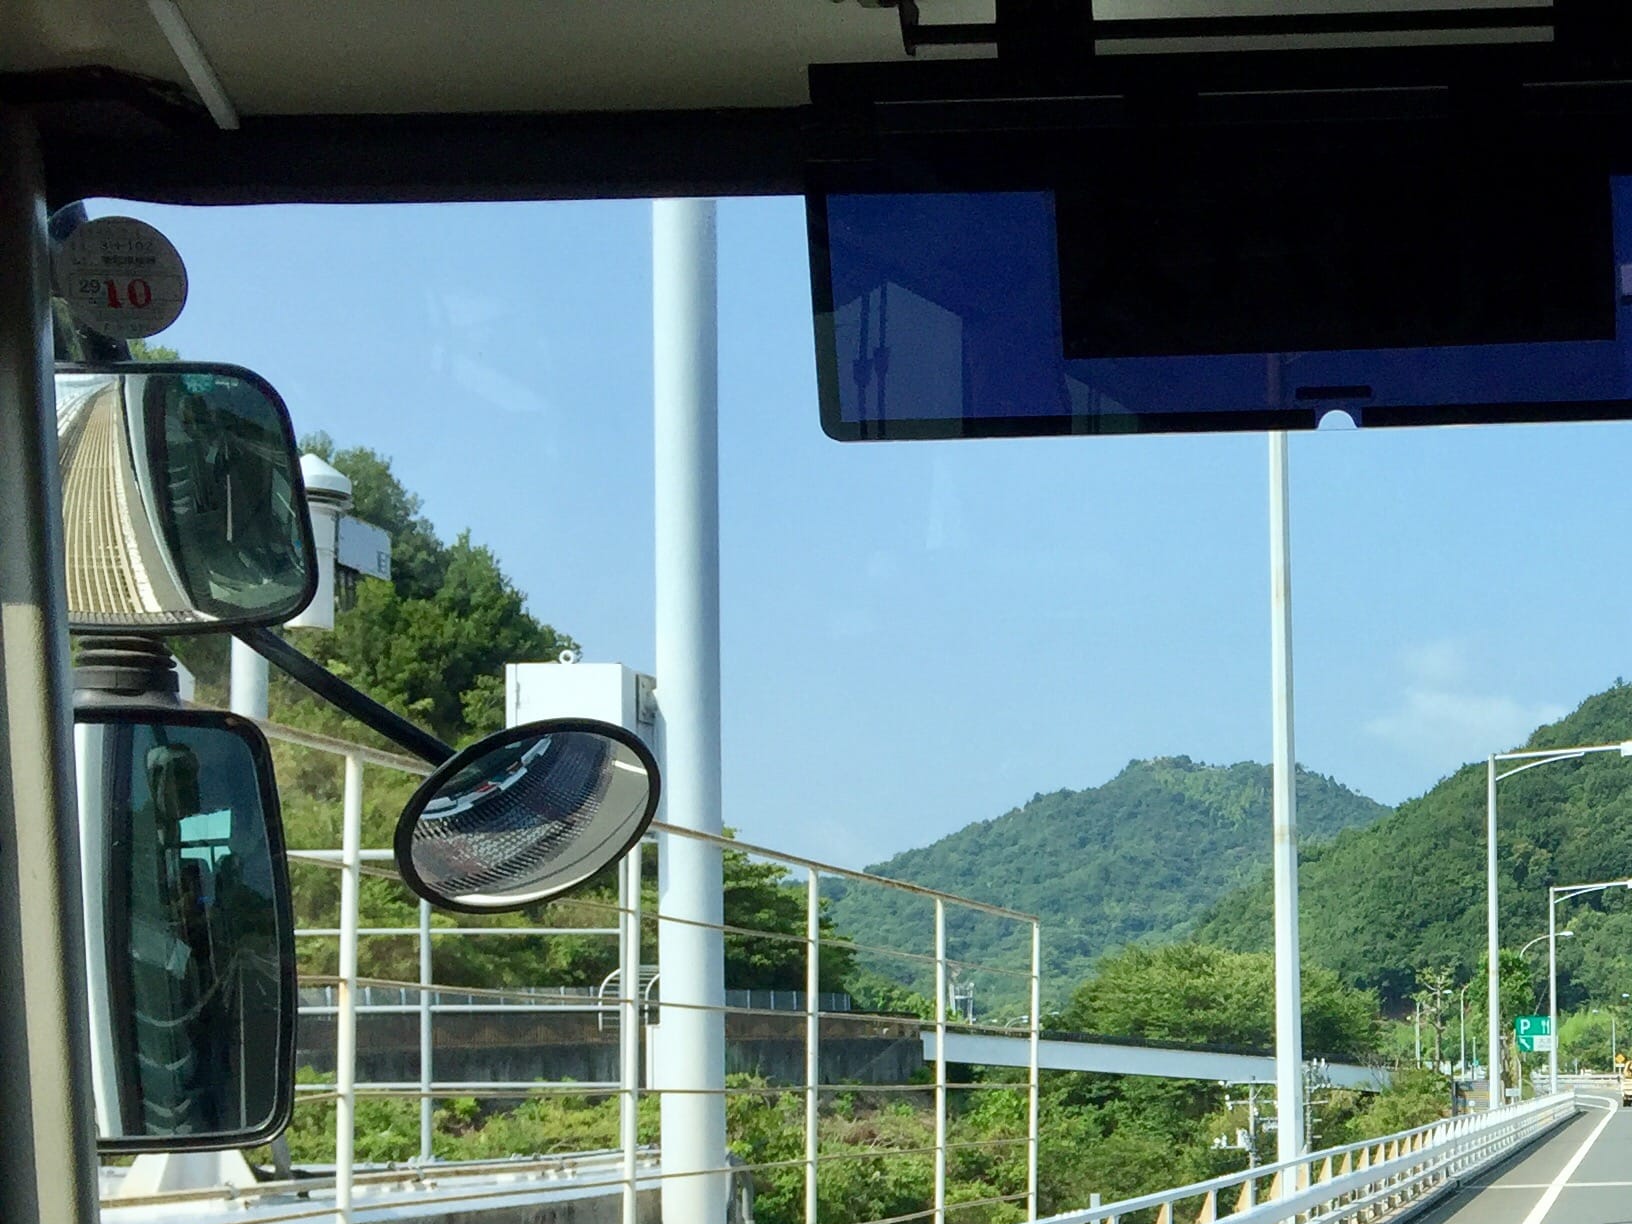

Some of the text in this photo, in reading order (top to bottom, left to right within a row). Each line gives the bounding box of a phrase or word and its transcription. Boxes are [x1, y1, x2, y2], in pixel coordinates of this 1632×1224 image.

[79, 278, 152, 309] 29 10
[1520, 1019, 1531, 1035] P
